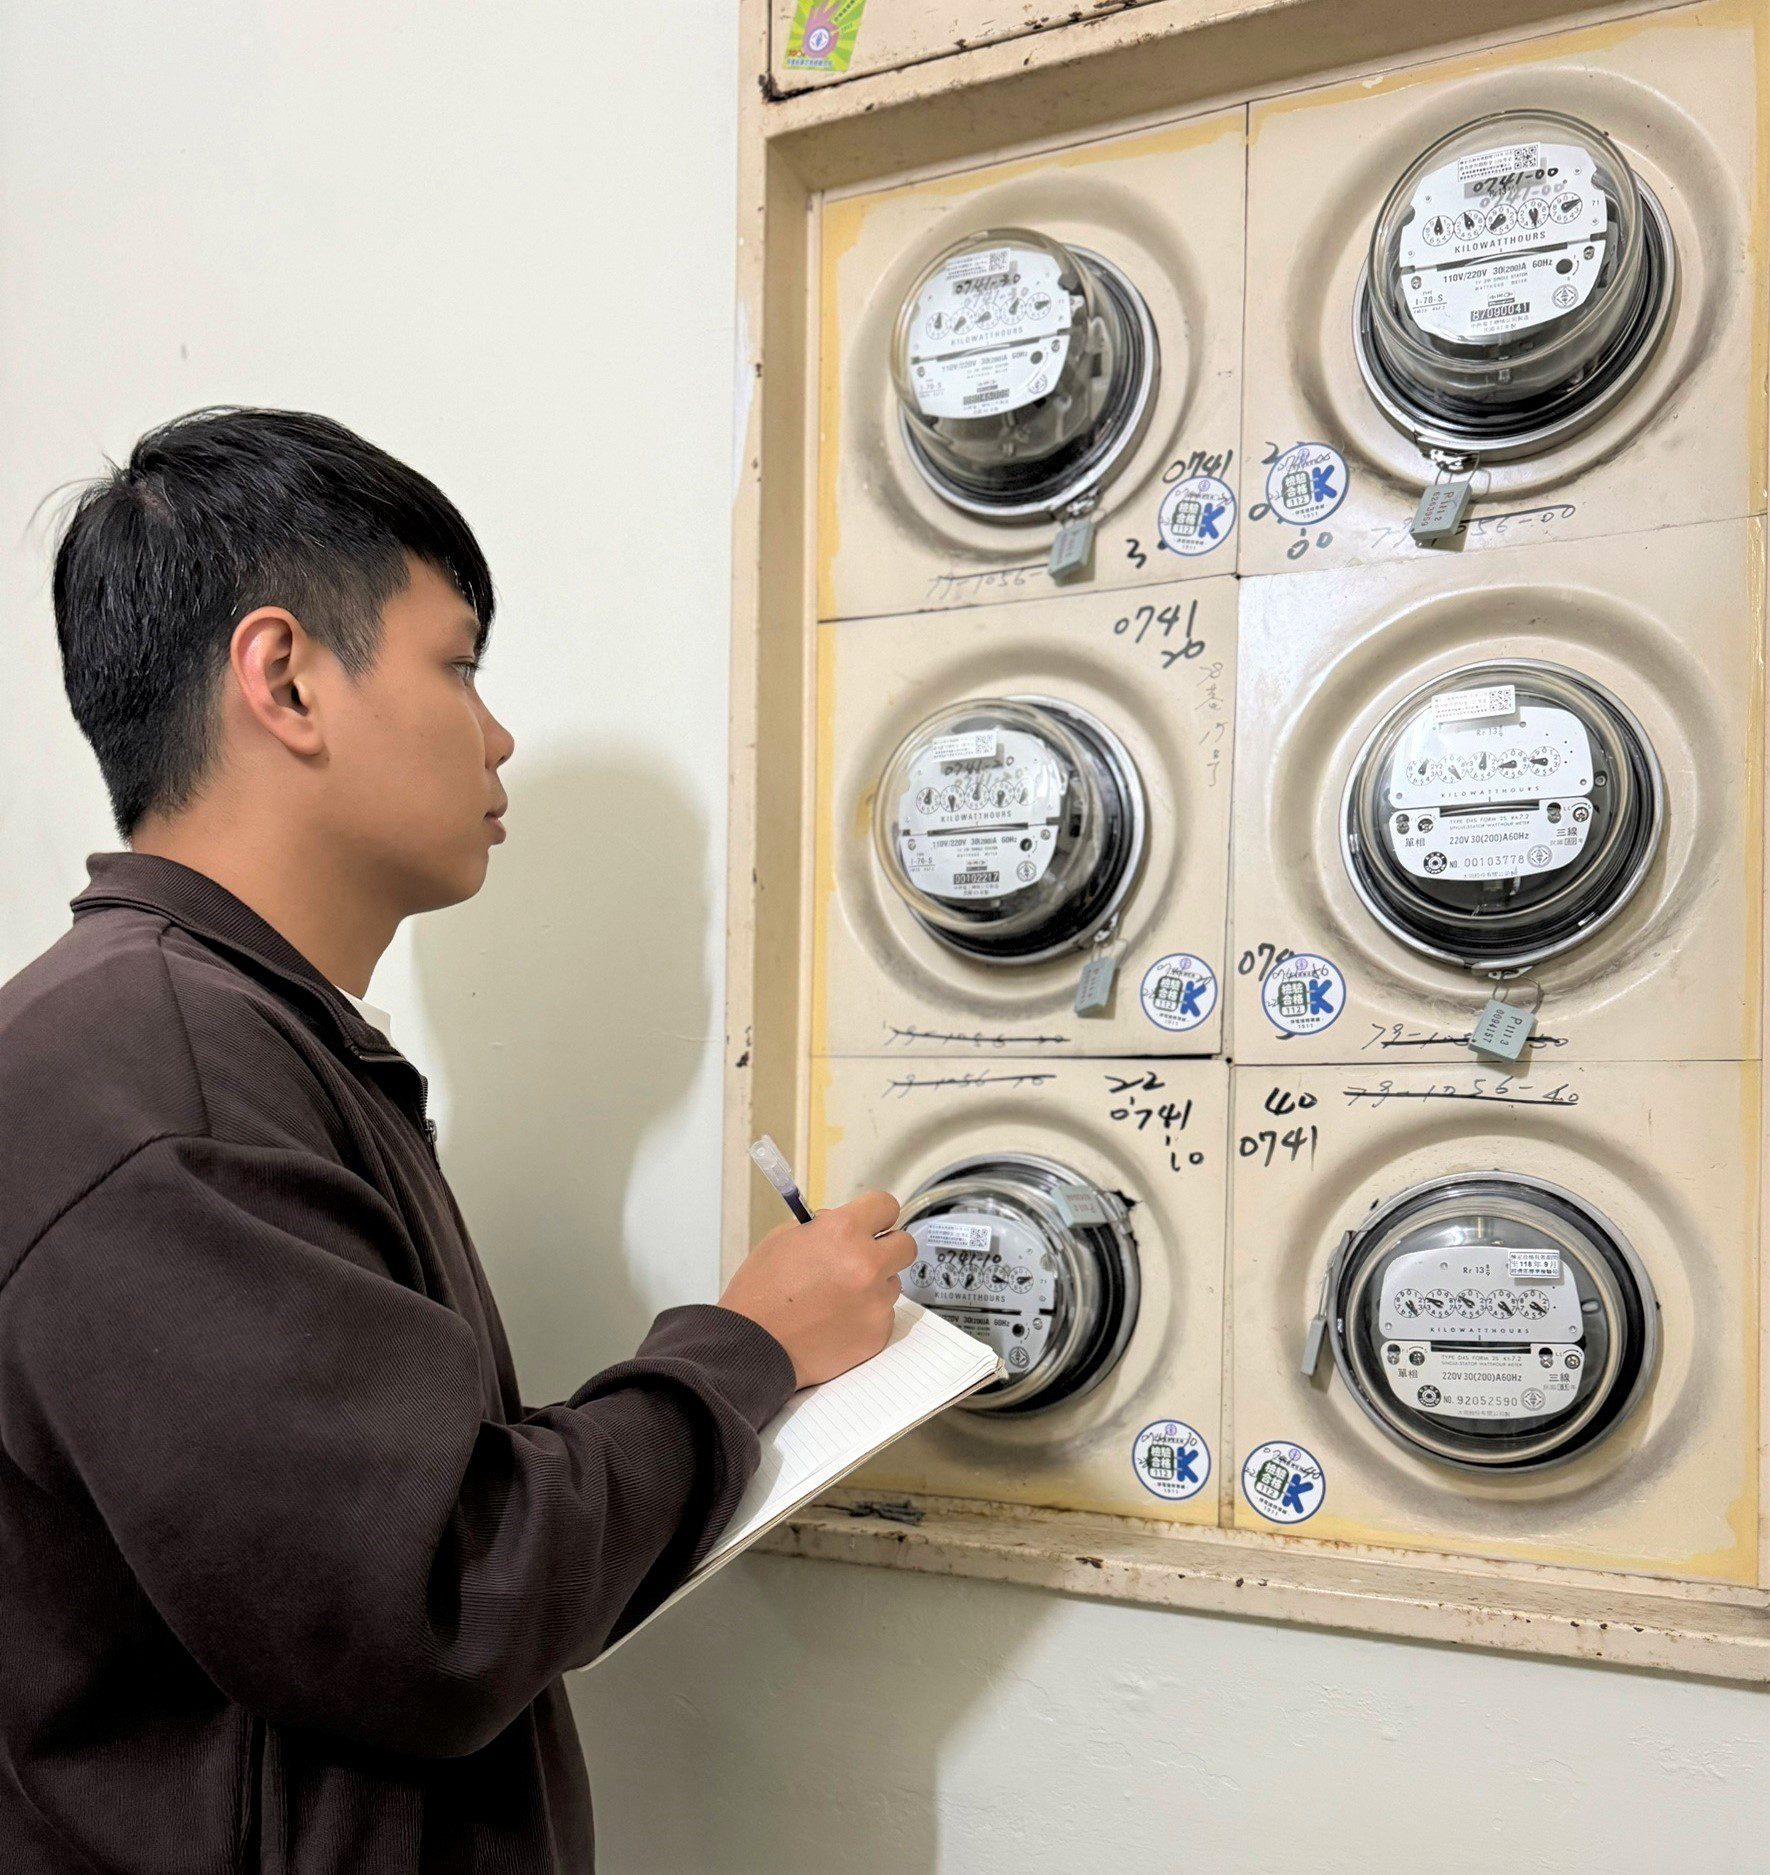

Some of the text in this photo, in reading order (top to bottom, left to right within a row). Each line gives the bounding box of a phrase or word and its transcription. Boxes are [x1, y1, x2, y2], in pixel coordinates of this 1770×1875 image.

[1473, 167, 1559, 193] 0741-00
[1454, 231, 1547, 254] KILOWATTHOURS
[1444, 269, 1488, 283] 110V/220V
[1532, 258, 1553, 269] 60Hz
[951, 327, 1024, 346] KILOWATTHOURS
[1162, 449, 1234, 484] 0741
[1312, 464, 1338, 503] K
[1291, 496, 1307, 506] 112
[1198, 502, 1226, 540] K
[1114, 599, 1197, 644] 0741
[1441, 785, 1540, 798] KILOWATTHOURS
[940, 810, 1012, 823] KILOWATTHOURS
[1449, 835, 1469, 846] 220V
[1464, 854, 1525, 868] 00103778
[1180, 980, 1207, 1018] K
[1309, 978, 1335, 1015] K
[1286, 1005, 1301, 1014] 112
[1264, 1087, 1318, 1116] 40
[1110, 1099, 1193, 1130] 0741
[1239, 1124, 1318, 1171] 0741
[934, 1292, 1006, 1303] KILOWATTHOURS
[1430, 1327, 1530, 1335] KILOWATTHOURS
[1442, 1371, 1462, 1381] 220V
[1457, 1395, 1518, 1407] 92052590
[1176, 1446, 1199, 1484] K
[1282, 1473, 1314, 1514] K
